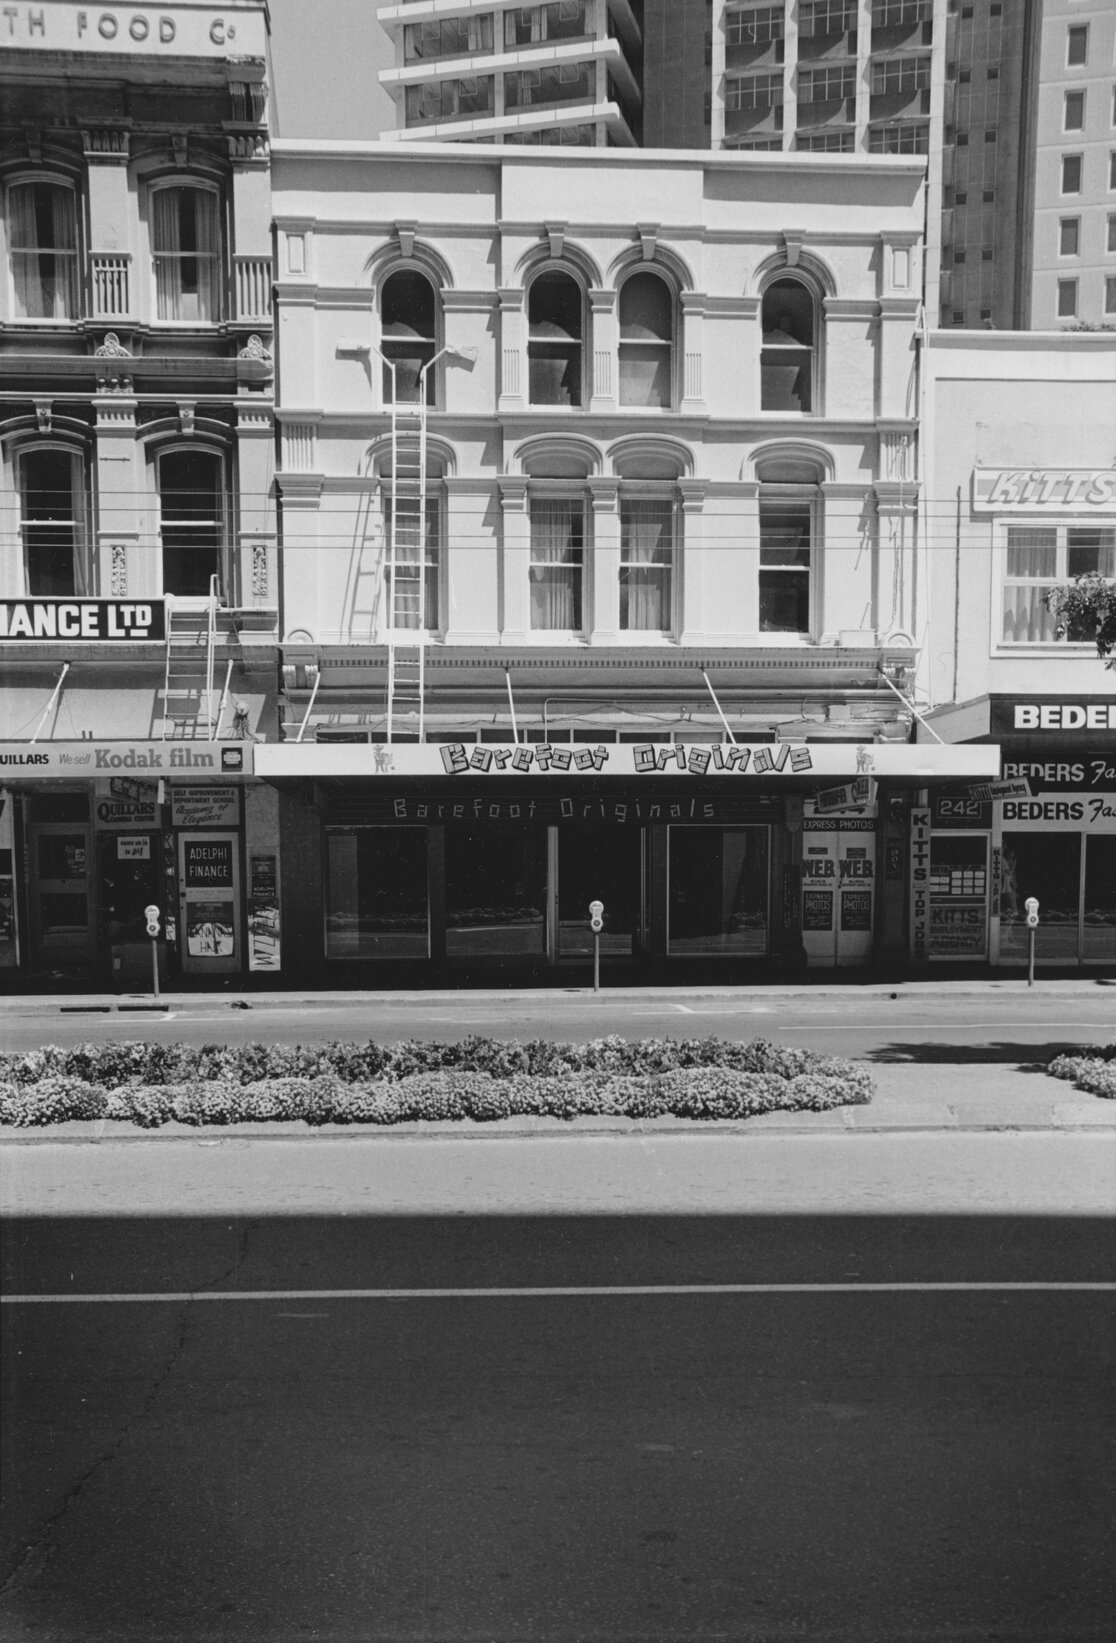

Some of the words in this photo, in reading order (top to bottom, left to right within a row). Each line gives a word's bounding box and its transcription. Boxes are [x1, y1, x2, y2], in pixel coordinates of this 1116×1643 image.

[3, 7, 46, 37] TH
[77, 11, 176, 44] FOOD
[59, 754, 74, 765] We
[75, 754, 91, 765] sell
[94, 748, 163, 768] Kodak
[169, 747, 214, 767] film
[440, 743, 609, 774] Barefoot
[633, 743, 813, 774] Originals
[1003, 763, 1085, 781] BEDERS
[1090, 760, 1116, 784] Fa
[394, 798, 537, 818] Barefoot
[561, 797, 714, 823] Originals
[940, 800, 978, 815] 242
[1002, 801, 1084, 820] BEDERS
[803, 820, 836, 831] EXPRESS
[839, 820, 874, 830] PHOTOS
[190, 848, 227, 860] ADELPHI
[913, 814, 929, 881] KITTS
[189, 866, 229, 878] FINANCE
[801, 859, 835, 878] WEB
[839, 859, 873, 878] WEB
[933, 909, 979, 924] KITTS
